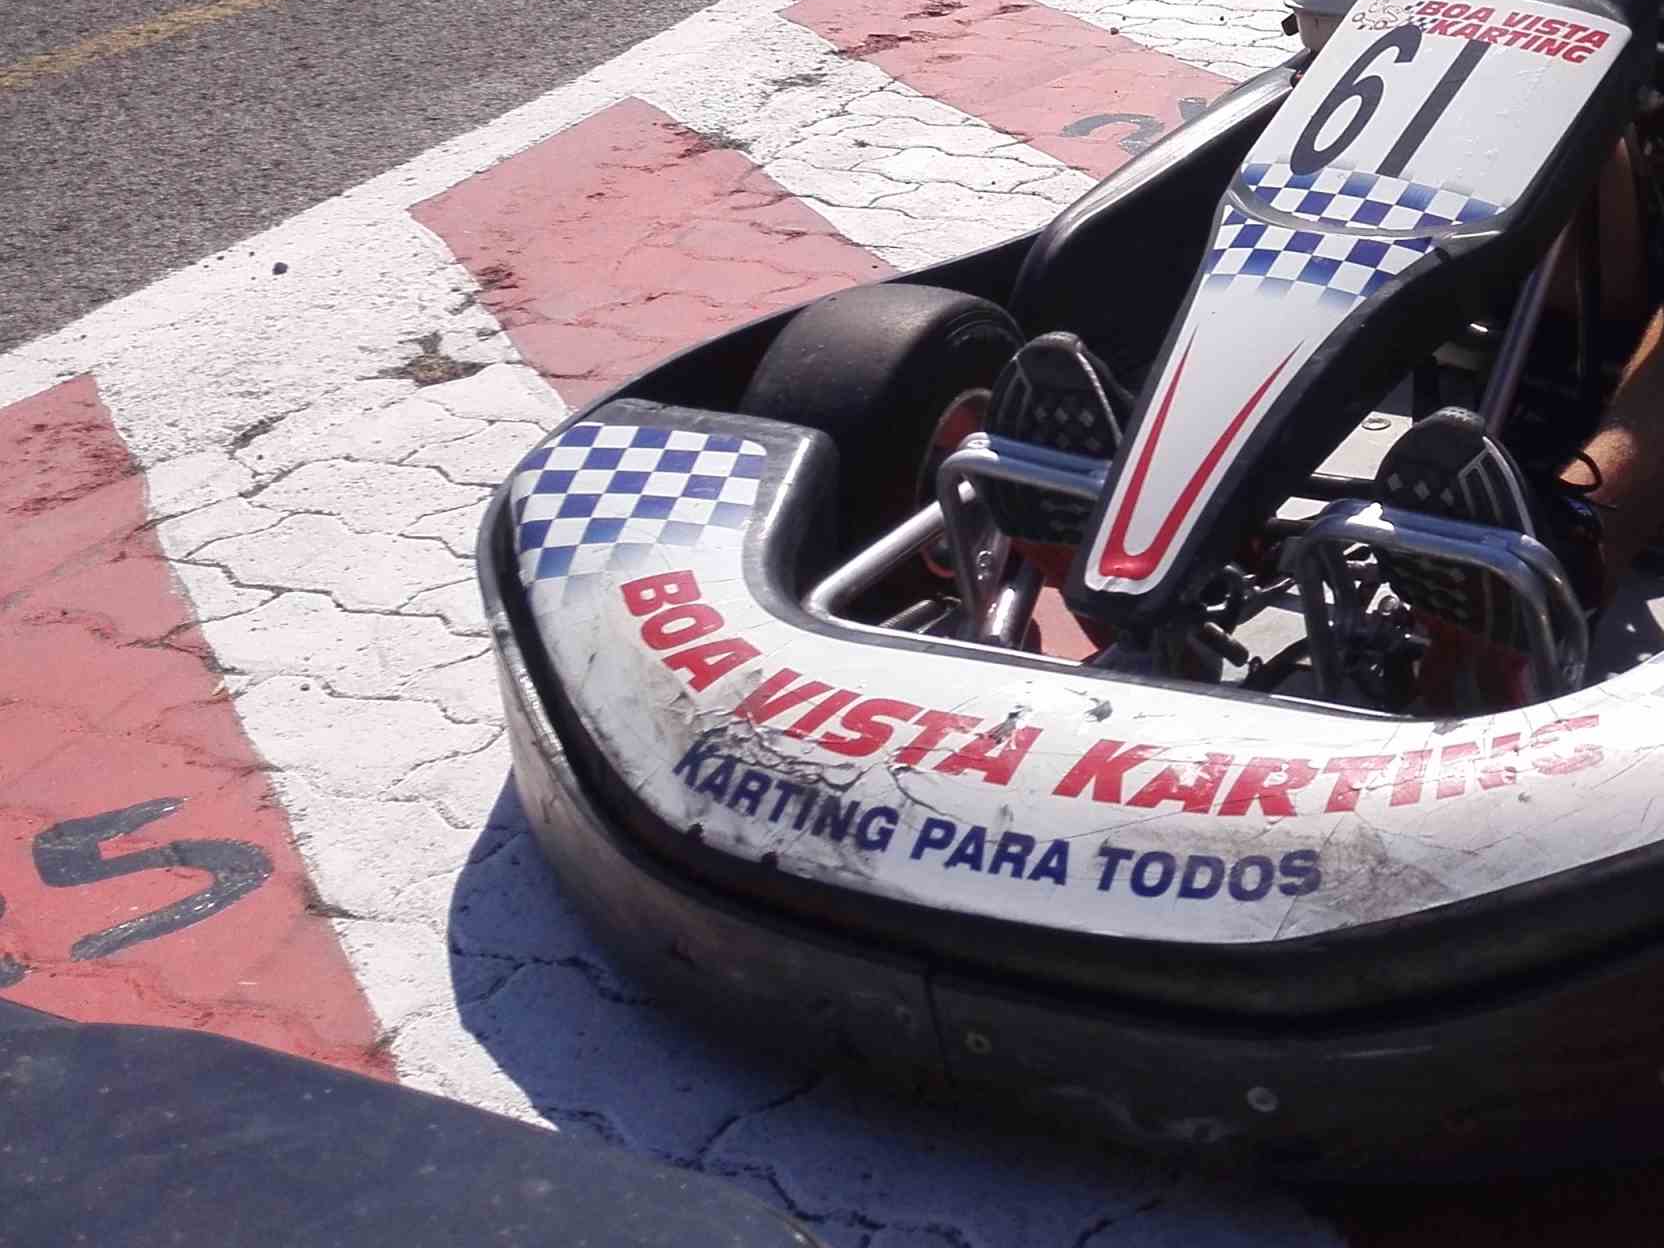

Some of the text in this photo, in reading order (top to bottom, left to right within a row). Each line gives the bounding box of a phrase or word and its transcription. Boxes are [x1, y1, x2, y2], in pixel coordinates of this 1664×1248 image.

[1289, 23, 1492, 177] 61
[1416, 1, 1611, 49] BOA VISTA
[1425, 19, 1595, 64] KARTING
[620, 569, 1605, 818] BOA VISTA KARTING
[674, 742, 1322, 902] KARTING PARA TODOS
